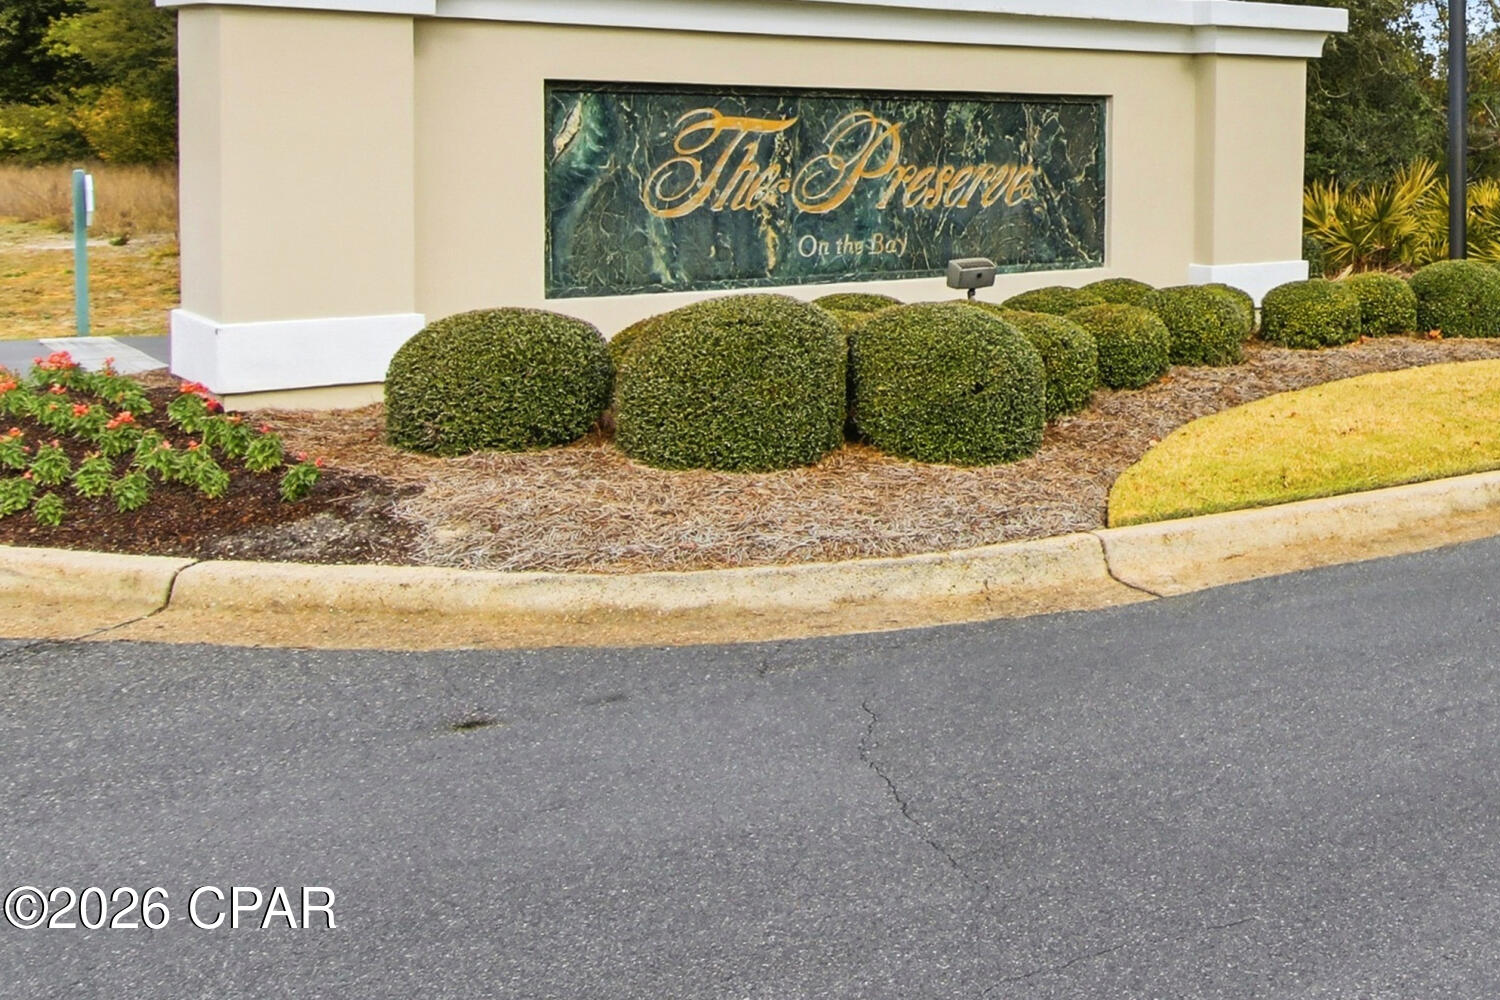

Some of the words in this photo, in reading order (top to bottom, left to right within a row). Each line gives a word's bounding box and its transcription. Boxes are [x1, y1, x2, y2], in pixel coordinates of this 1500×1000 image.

[643, 107, 798, 219] The
[792, 110, 1036, 214] Preserve
[798, 234, 829, 257] On
[836, 233, 863, 255] the
[866, 232, 908, 258] Bay
